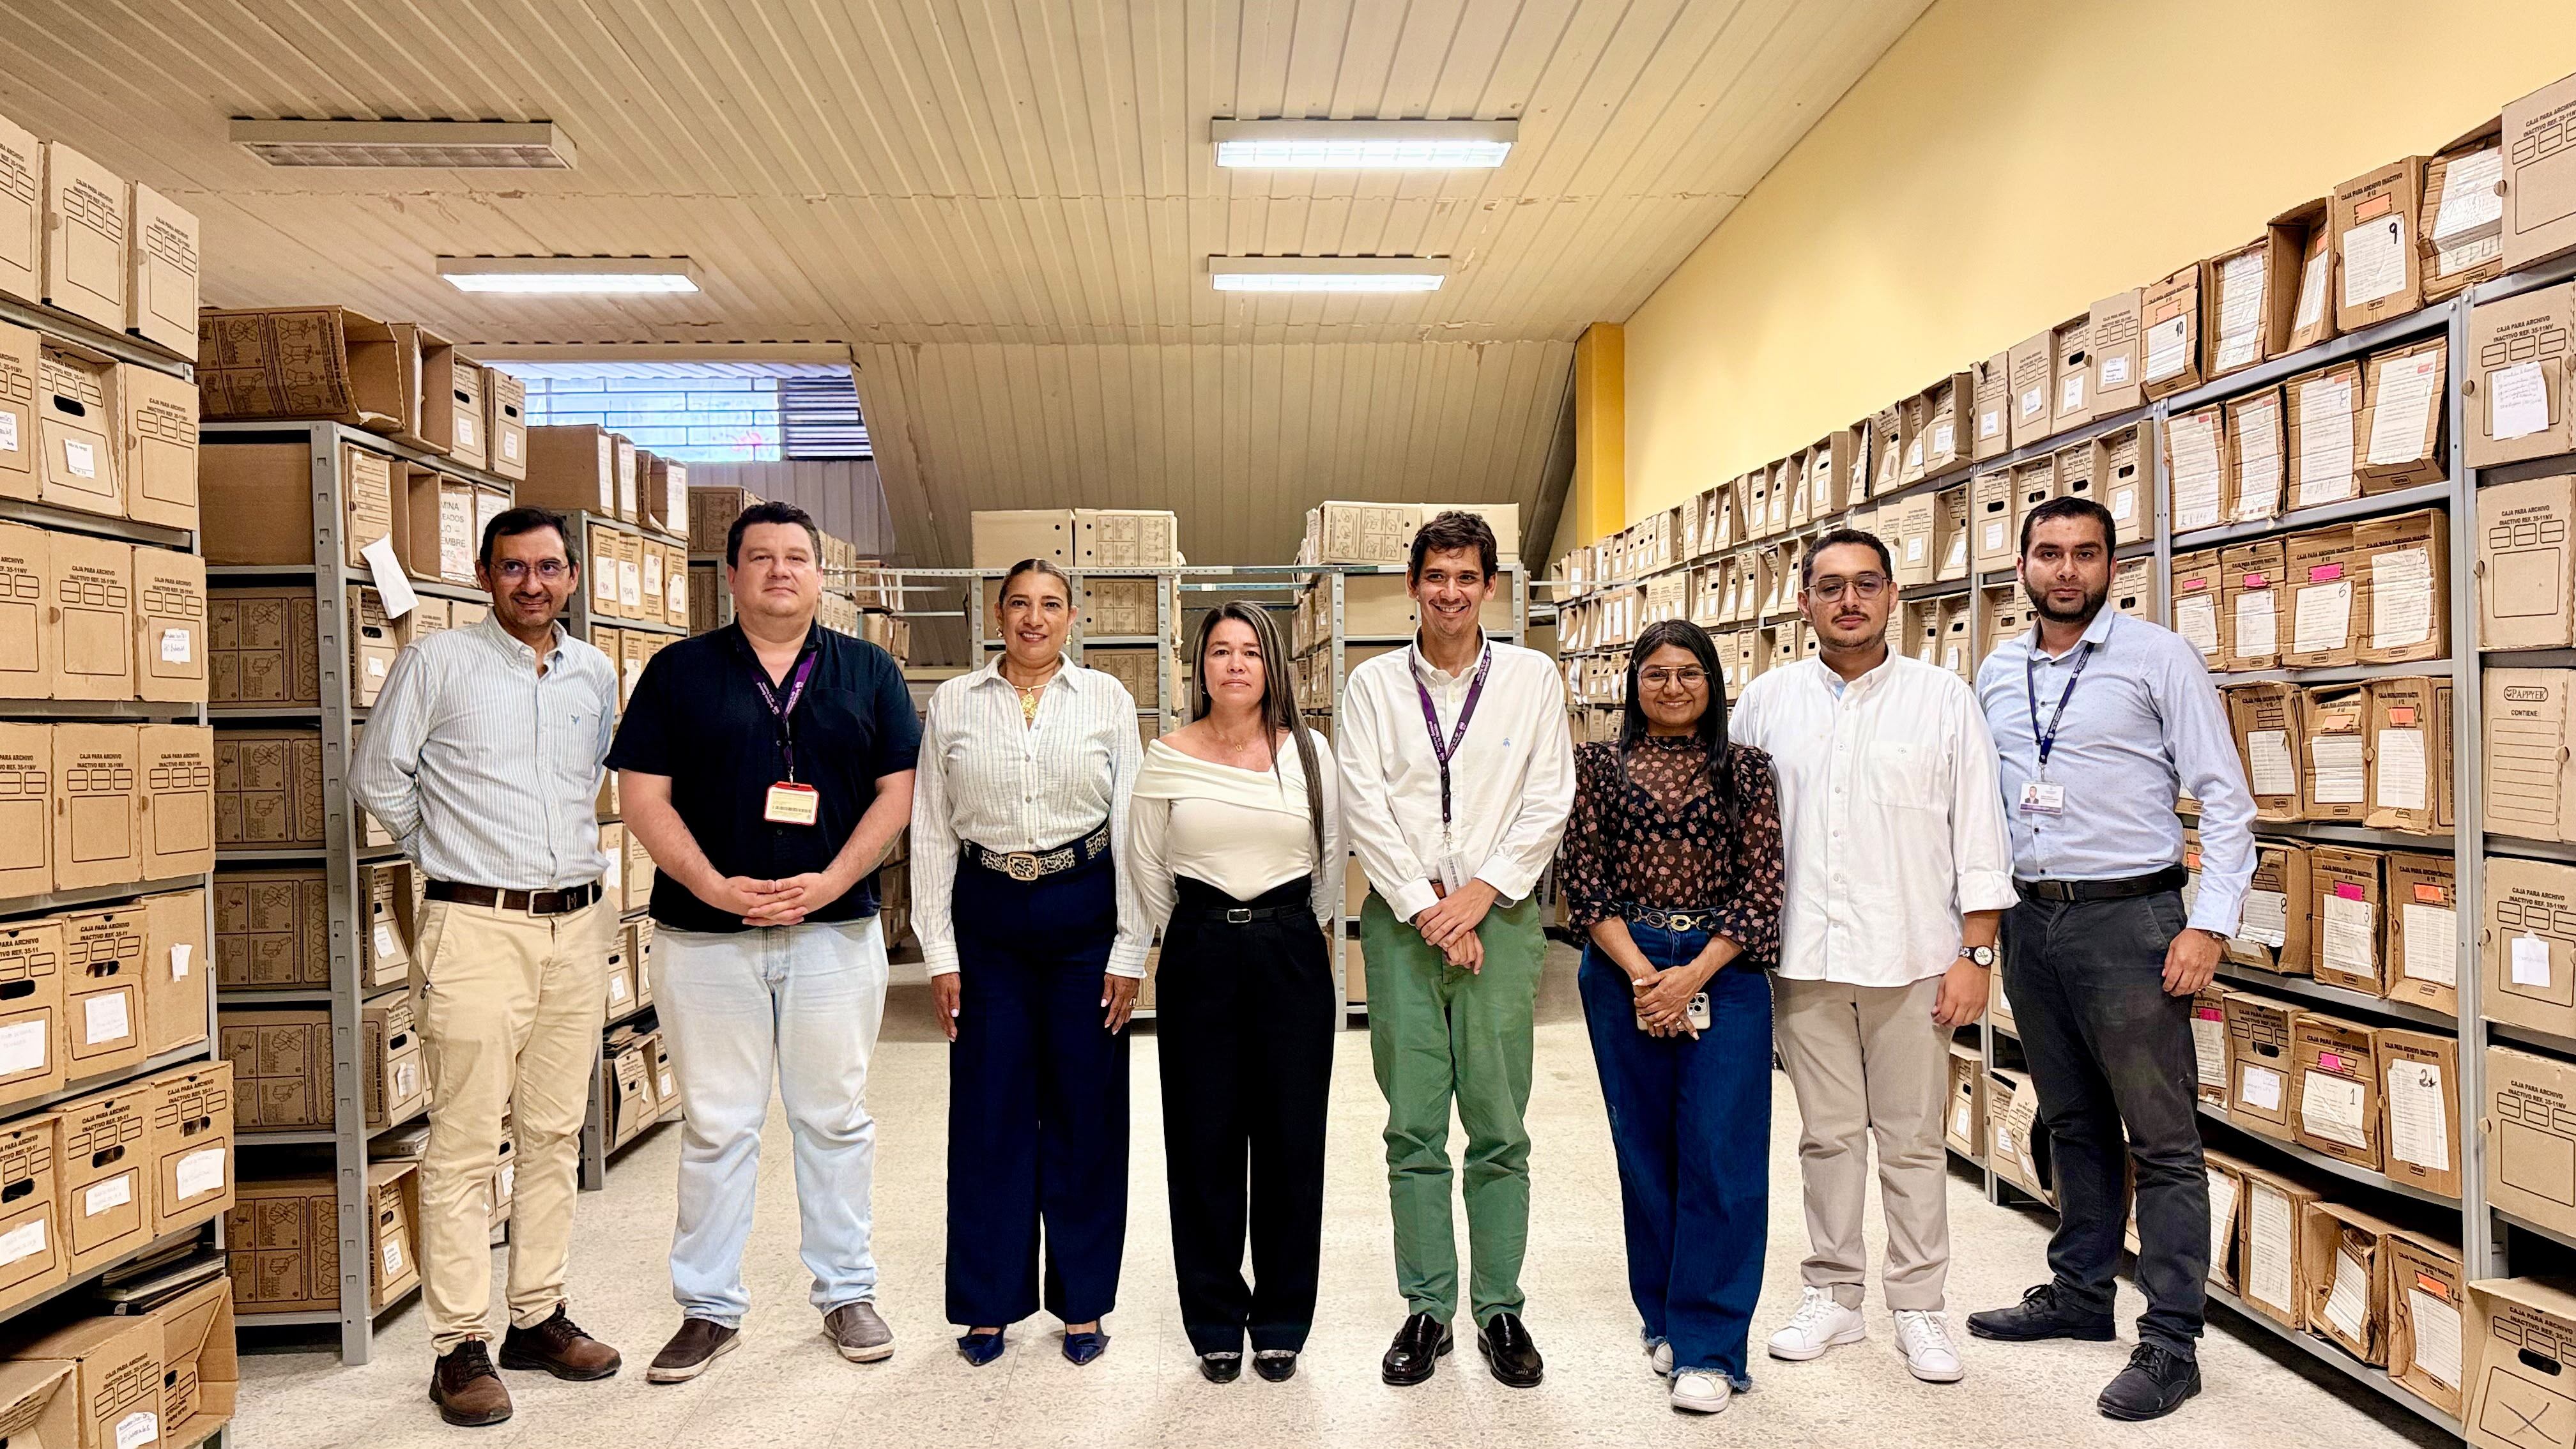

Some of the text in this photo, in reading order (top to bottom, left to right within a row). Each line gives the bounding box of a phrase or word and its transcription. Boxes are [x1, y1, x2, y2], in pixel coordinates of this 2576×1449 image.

[2526, 118, 2539, 127] CAJA
[2540, 111, 2553, 121] PARA
[2352, 188, 2363, 197] PARA
[2389, 222, 2398, 245] 9
[2175, 321, 2184, 337] 10
[2496, 316, 2550, 334] CAJA PARA ARCHIVO
[2493, 332, 2518, 343] INACTIVO
[2528, 505, 2550, 514] ARCHIVO
[2499, 518, 2521, 526] INACTIVO
[1, 556, 24, 565] ARCHIVO
[2418, 548, 2426, 565] 5
[2338, 583, 2347, 598] 6
[2206, 595, 2212, 611] 8
[2512, 689, 2544, 700] PAPPYER
[2416, 702, 2423, 723] 2
[2509, 896, 2533, 905] INACTIVO
[2541, 892, 2565, 901] ARCHIVO
[14, 937, 39, 946] ARCHIVO
[2320, 1037, 2332, 1046] PARA
[2419, 1068, 2428, 1087] 2
[167, 1079, 214, 1096] CAJA PARA ARCHIVO
[2508, 1088, 2532, 1100] INACTIVO
[2511, 1080, 2563, 1100] CAJA PARA ARCHIVO
[2349, 1087, 2356, 1105] 1
[5, 1135, 38, 1150] PARA ARCHIVO
[2451, 1287, 2464, 1309] 4
[2509, 1306, 2573, 1335] CAJA PARA ARCHIVO
[2510, 1315, 2572, 1343] INACTIVO REF. 35-11
